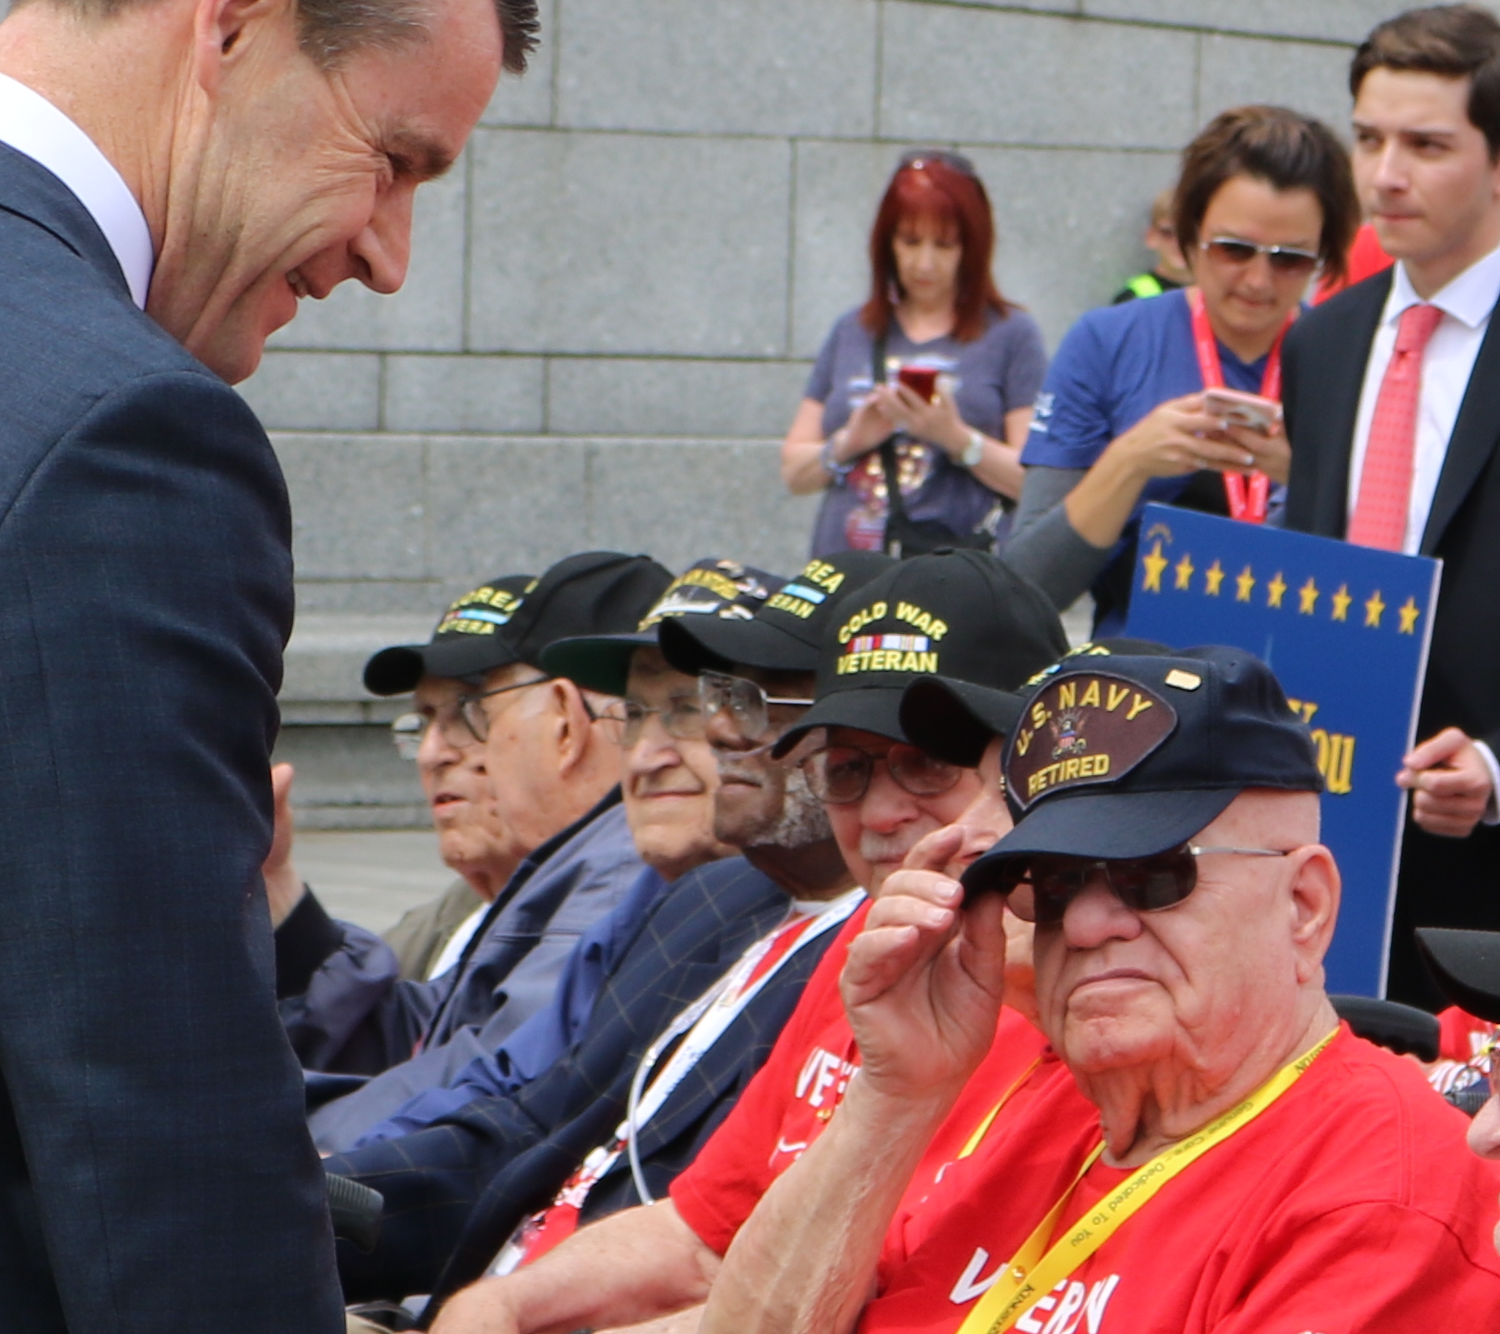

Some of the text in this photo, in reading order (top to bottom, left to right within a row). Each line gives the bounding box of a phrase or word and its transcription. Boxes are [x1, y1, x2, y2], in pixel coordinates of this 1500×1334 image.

[802, 559, 846, 595] REA
[767, 591, 814, 620] ERAN
[837, 600, 949, 646] COLD WAR
[836, 650, 939, 676] VETERAN
[1016, 679, 1153, 757] U.S. NAVY
[1027, 753, 1111, 799] RETIRED
[1108, 1161, 1165, 1215] Dedicated
[1091, 1211, 1110, 1227] To
[1070, 1228, 1094, 1249] You
